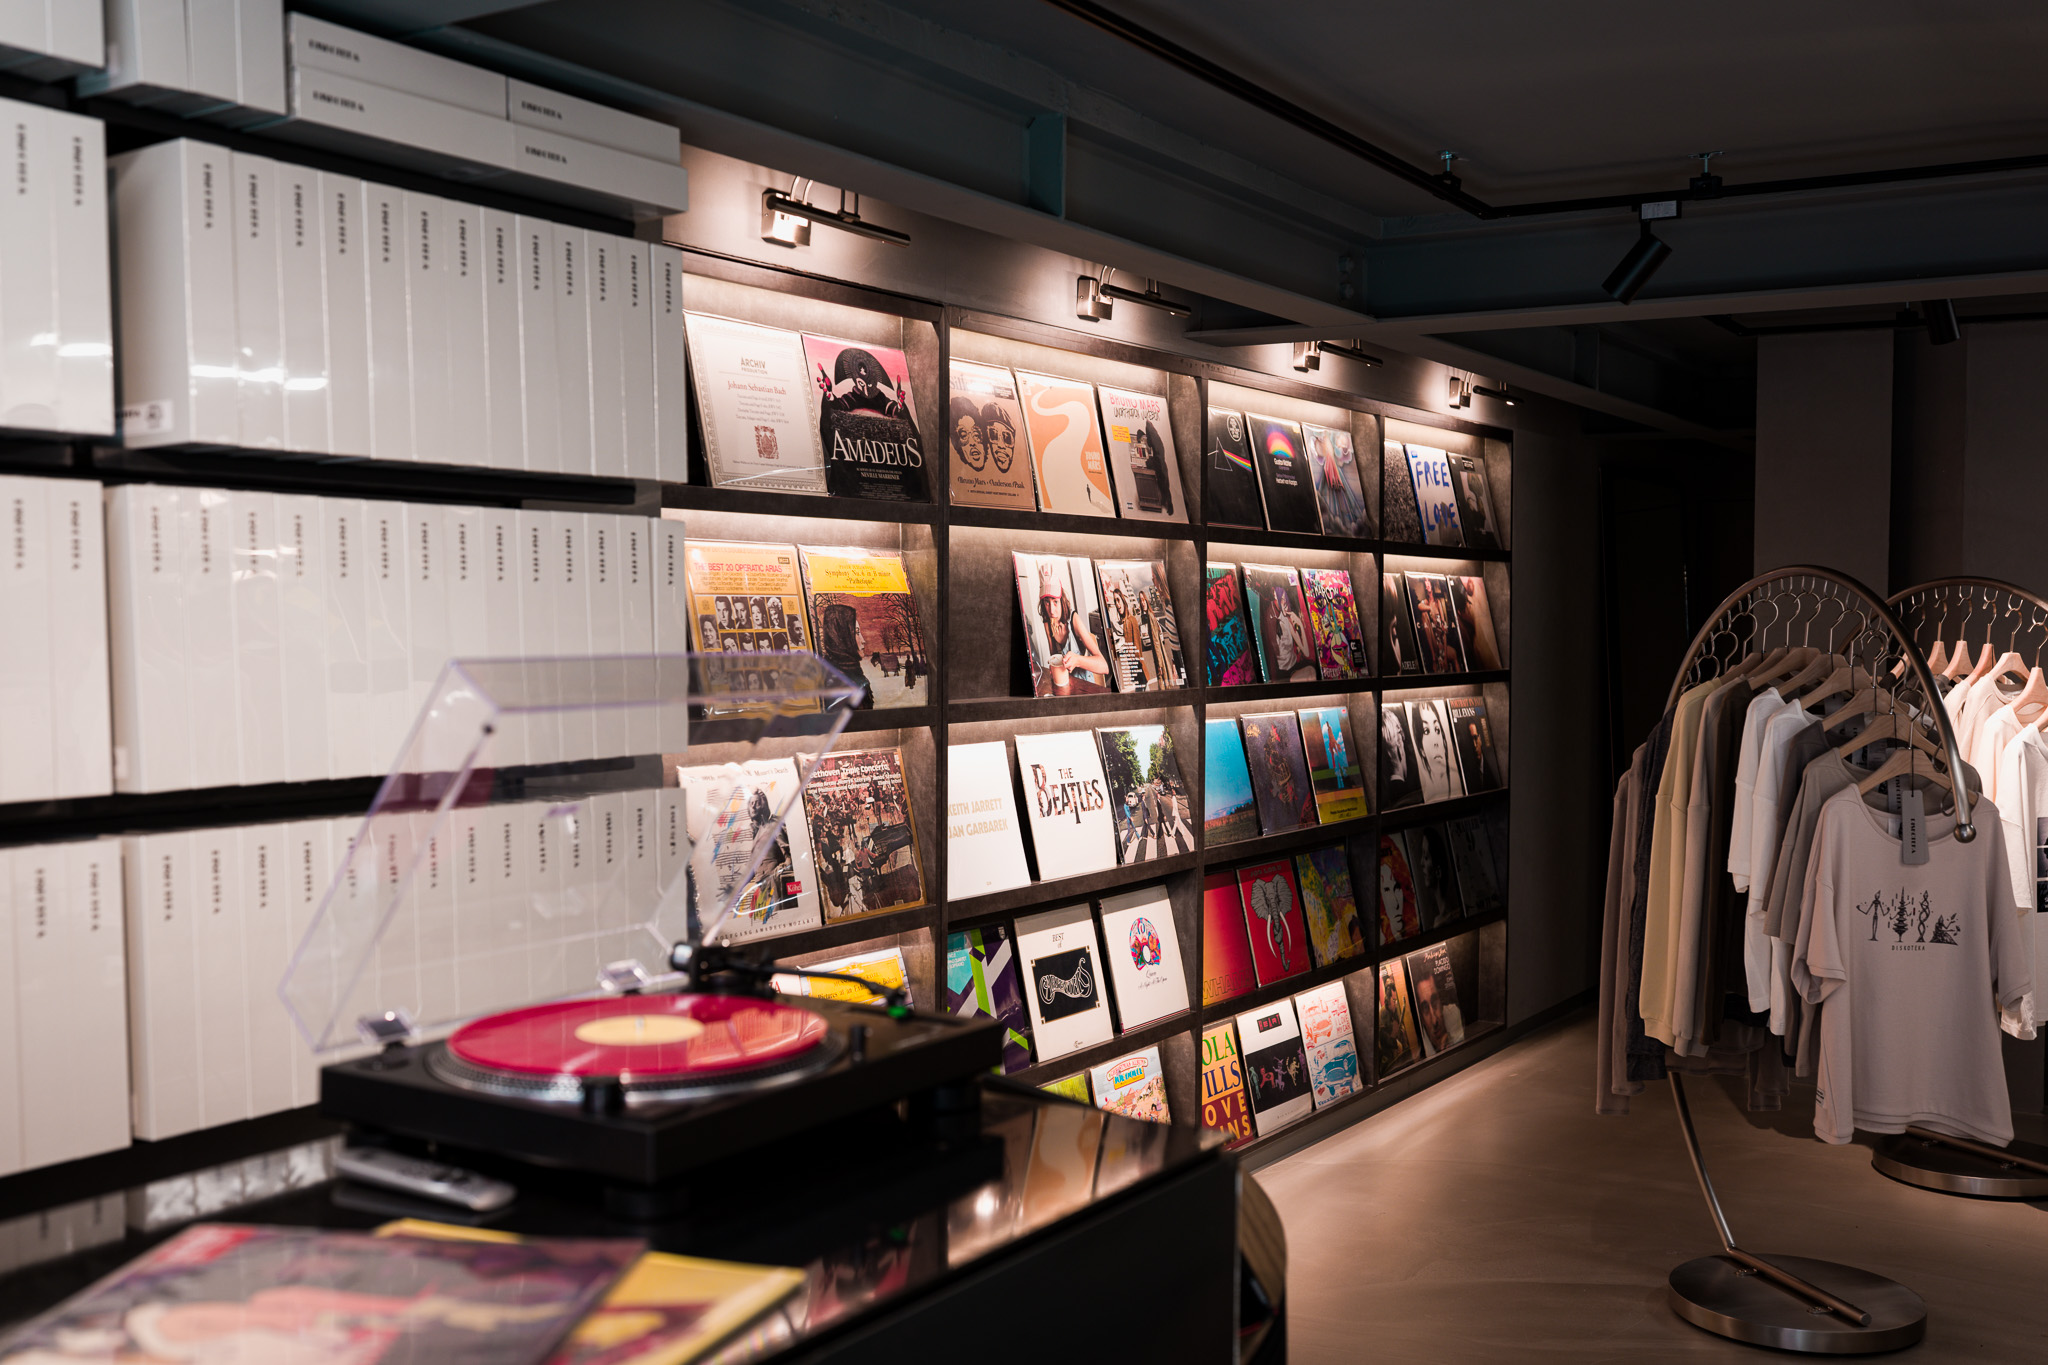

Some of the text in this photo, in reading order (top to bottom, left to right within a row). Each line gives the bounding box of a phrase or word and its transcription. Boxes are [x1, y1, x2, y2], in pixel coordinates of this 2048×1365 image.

[741, 356, 766, 369] ARCHIV
[728, 380, 787, 395] Johann Sebastian Bach
[1109, 393, 1161, 413] BRUNO MARS
[831, 429, 922, 468] AMADEUS
[1415, 461, 1449, 490] FREE
[1425, 500, 1459, 532] LOVE
[708, 562, 724, 571] BEST
[725, 563, 734, 572] 20
[734, 563, 764, 573] OPERATIC
[765, 564, 783, 573] ARIAS
[825, 569, 850, 577] Symphony
[841, 766, 860, 775] Triple
[860, 763, 890, 773] Concerto
[1058, 767, 1074, 780] THE
[1030, 763, 1104, 825] BEATLES
[948, 797, 1003, 817] KEITH JARRETT
[949, 818, 1009, 839] JAN GARBAREK
[788, 918, 814, 928] MOZART
[1052, 932, 1064, 943] BEST
[1202, 1031, 1236, 1067] OLA
[1202, 1060, 1241, 1098] ILLS
[1205, 1091, 1247, 1127] OVE
